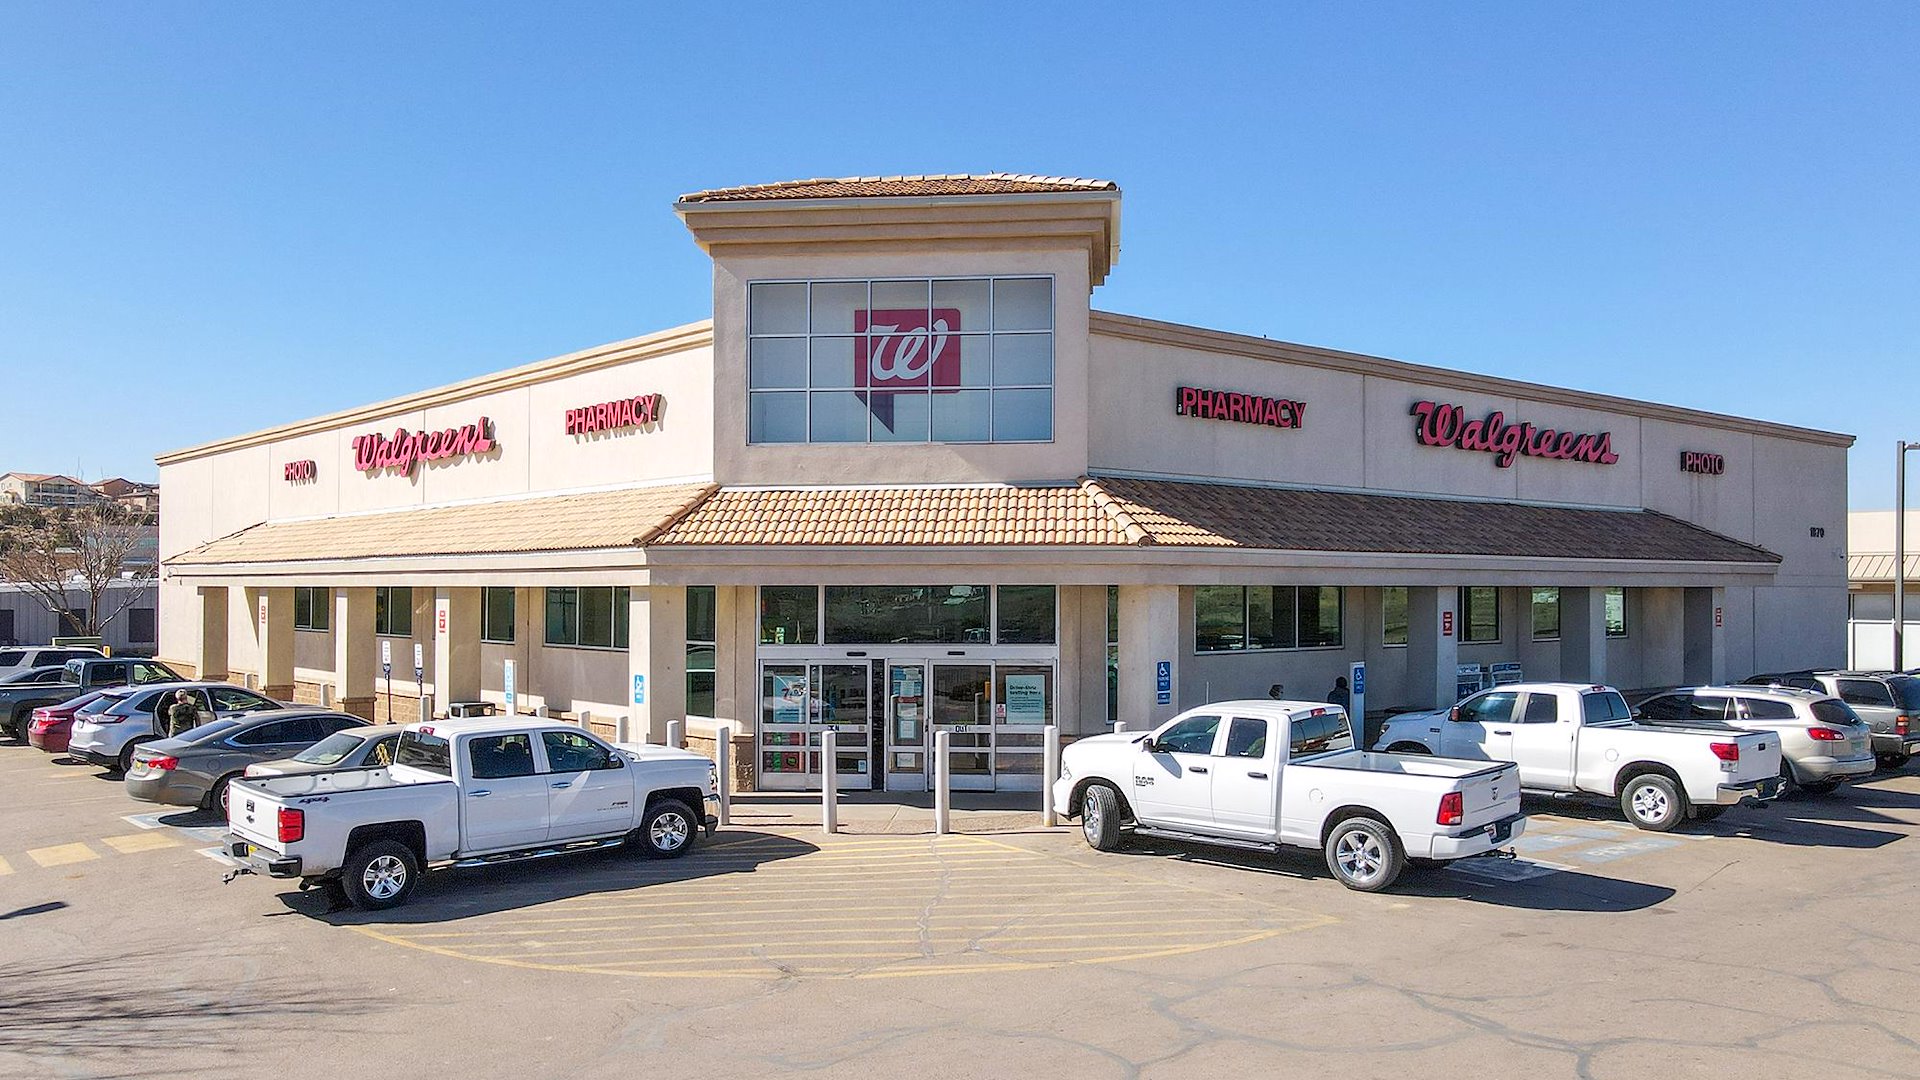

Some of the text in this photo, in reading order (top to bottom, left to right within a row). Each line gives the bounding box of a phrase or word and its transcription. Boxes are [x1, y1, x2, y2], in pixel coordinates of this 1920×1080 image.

[565, 392, 661, 436] PHARMACY
[1180, 386, 1307, 429] PHARMACY
[352, 416, 495, 478] Walgreens
[1412, 400, 1620, 468] Walgreens
[284, 459, 314, 481] PHOTO
[1683, 451, 1725, 475] PHOTO
[955, 725, 968, 733] OUT
